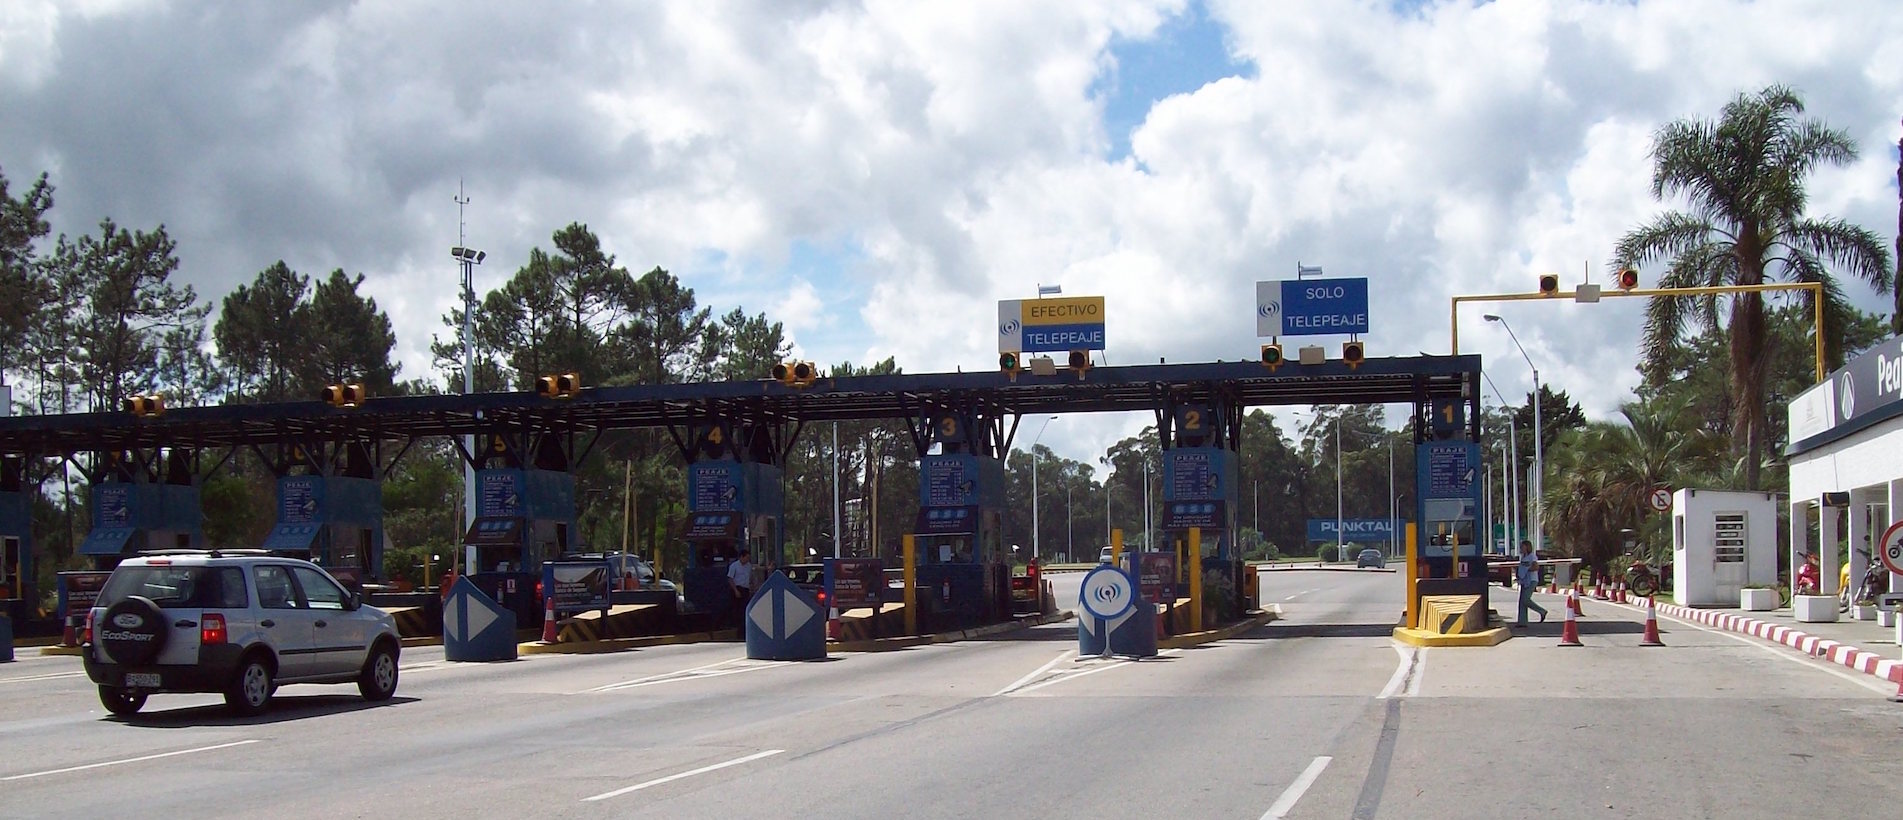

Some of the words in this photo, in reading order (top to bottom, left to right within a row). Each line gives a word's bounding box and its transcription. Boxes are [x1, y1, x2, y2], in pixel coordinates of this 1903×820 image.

[1306, 286, 1344, 299] SOLO
[1031, 304, 1097, 318] EFECTIVO
[1287, 313, 1366, 327] TELEPEAJE
[1027, 331, 1102, 344] TELEPEAJE
[1185, 410, 1200, 430] 2
[1443, 404, 1454, 424] 1
[708, 426, 722, 444] 4
[942, 418, 956, 436] 3
[494, 434, 507, 452] 5
